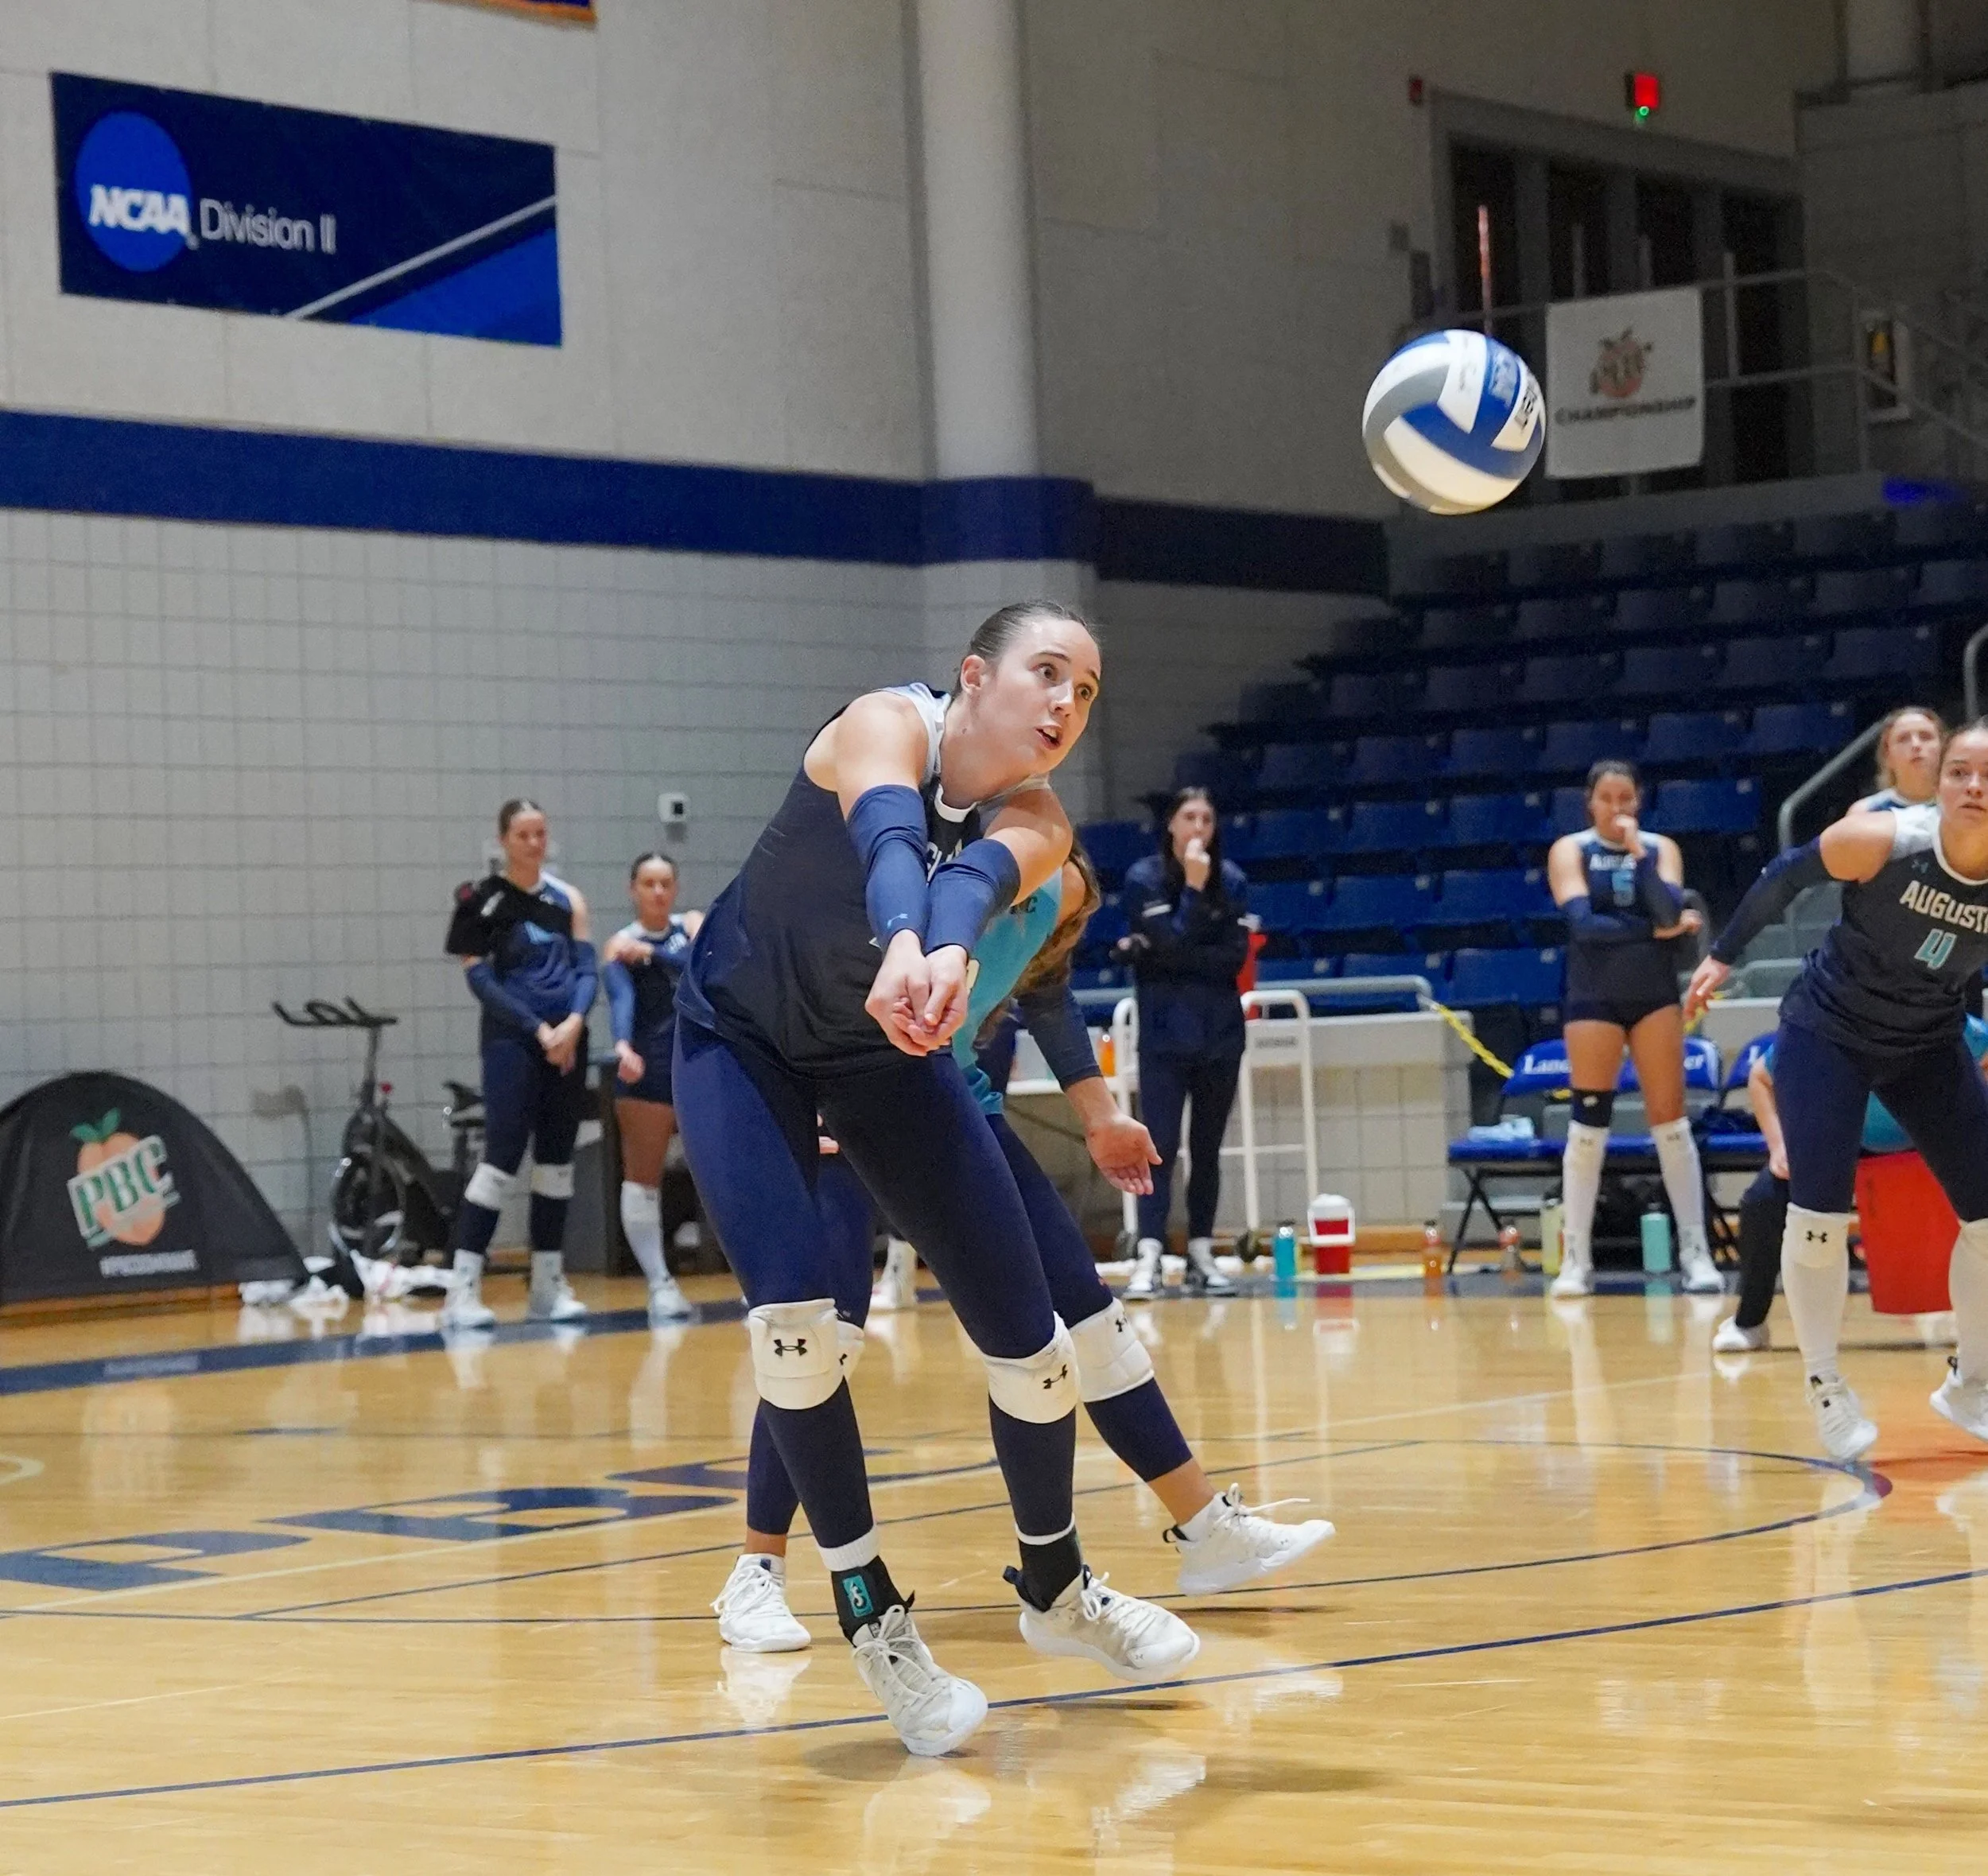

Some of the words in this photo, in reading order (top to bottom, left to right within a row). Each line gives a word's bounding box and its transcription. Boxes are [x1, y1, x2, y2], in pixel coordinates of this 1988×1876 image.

[88, 184, 189, 235] NCAA
[200, 198, 315, 251] Division
[320, 213, 336, 254] II
[1899, 880, 1988, 934] AUGUST
[1914, 927, 1958, 971] 4
[70, 1137, 168, 1237] PBC
